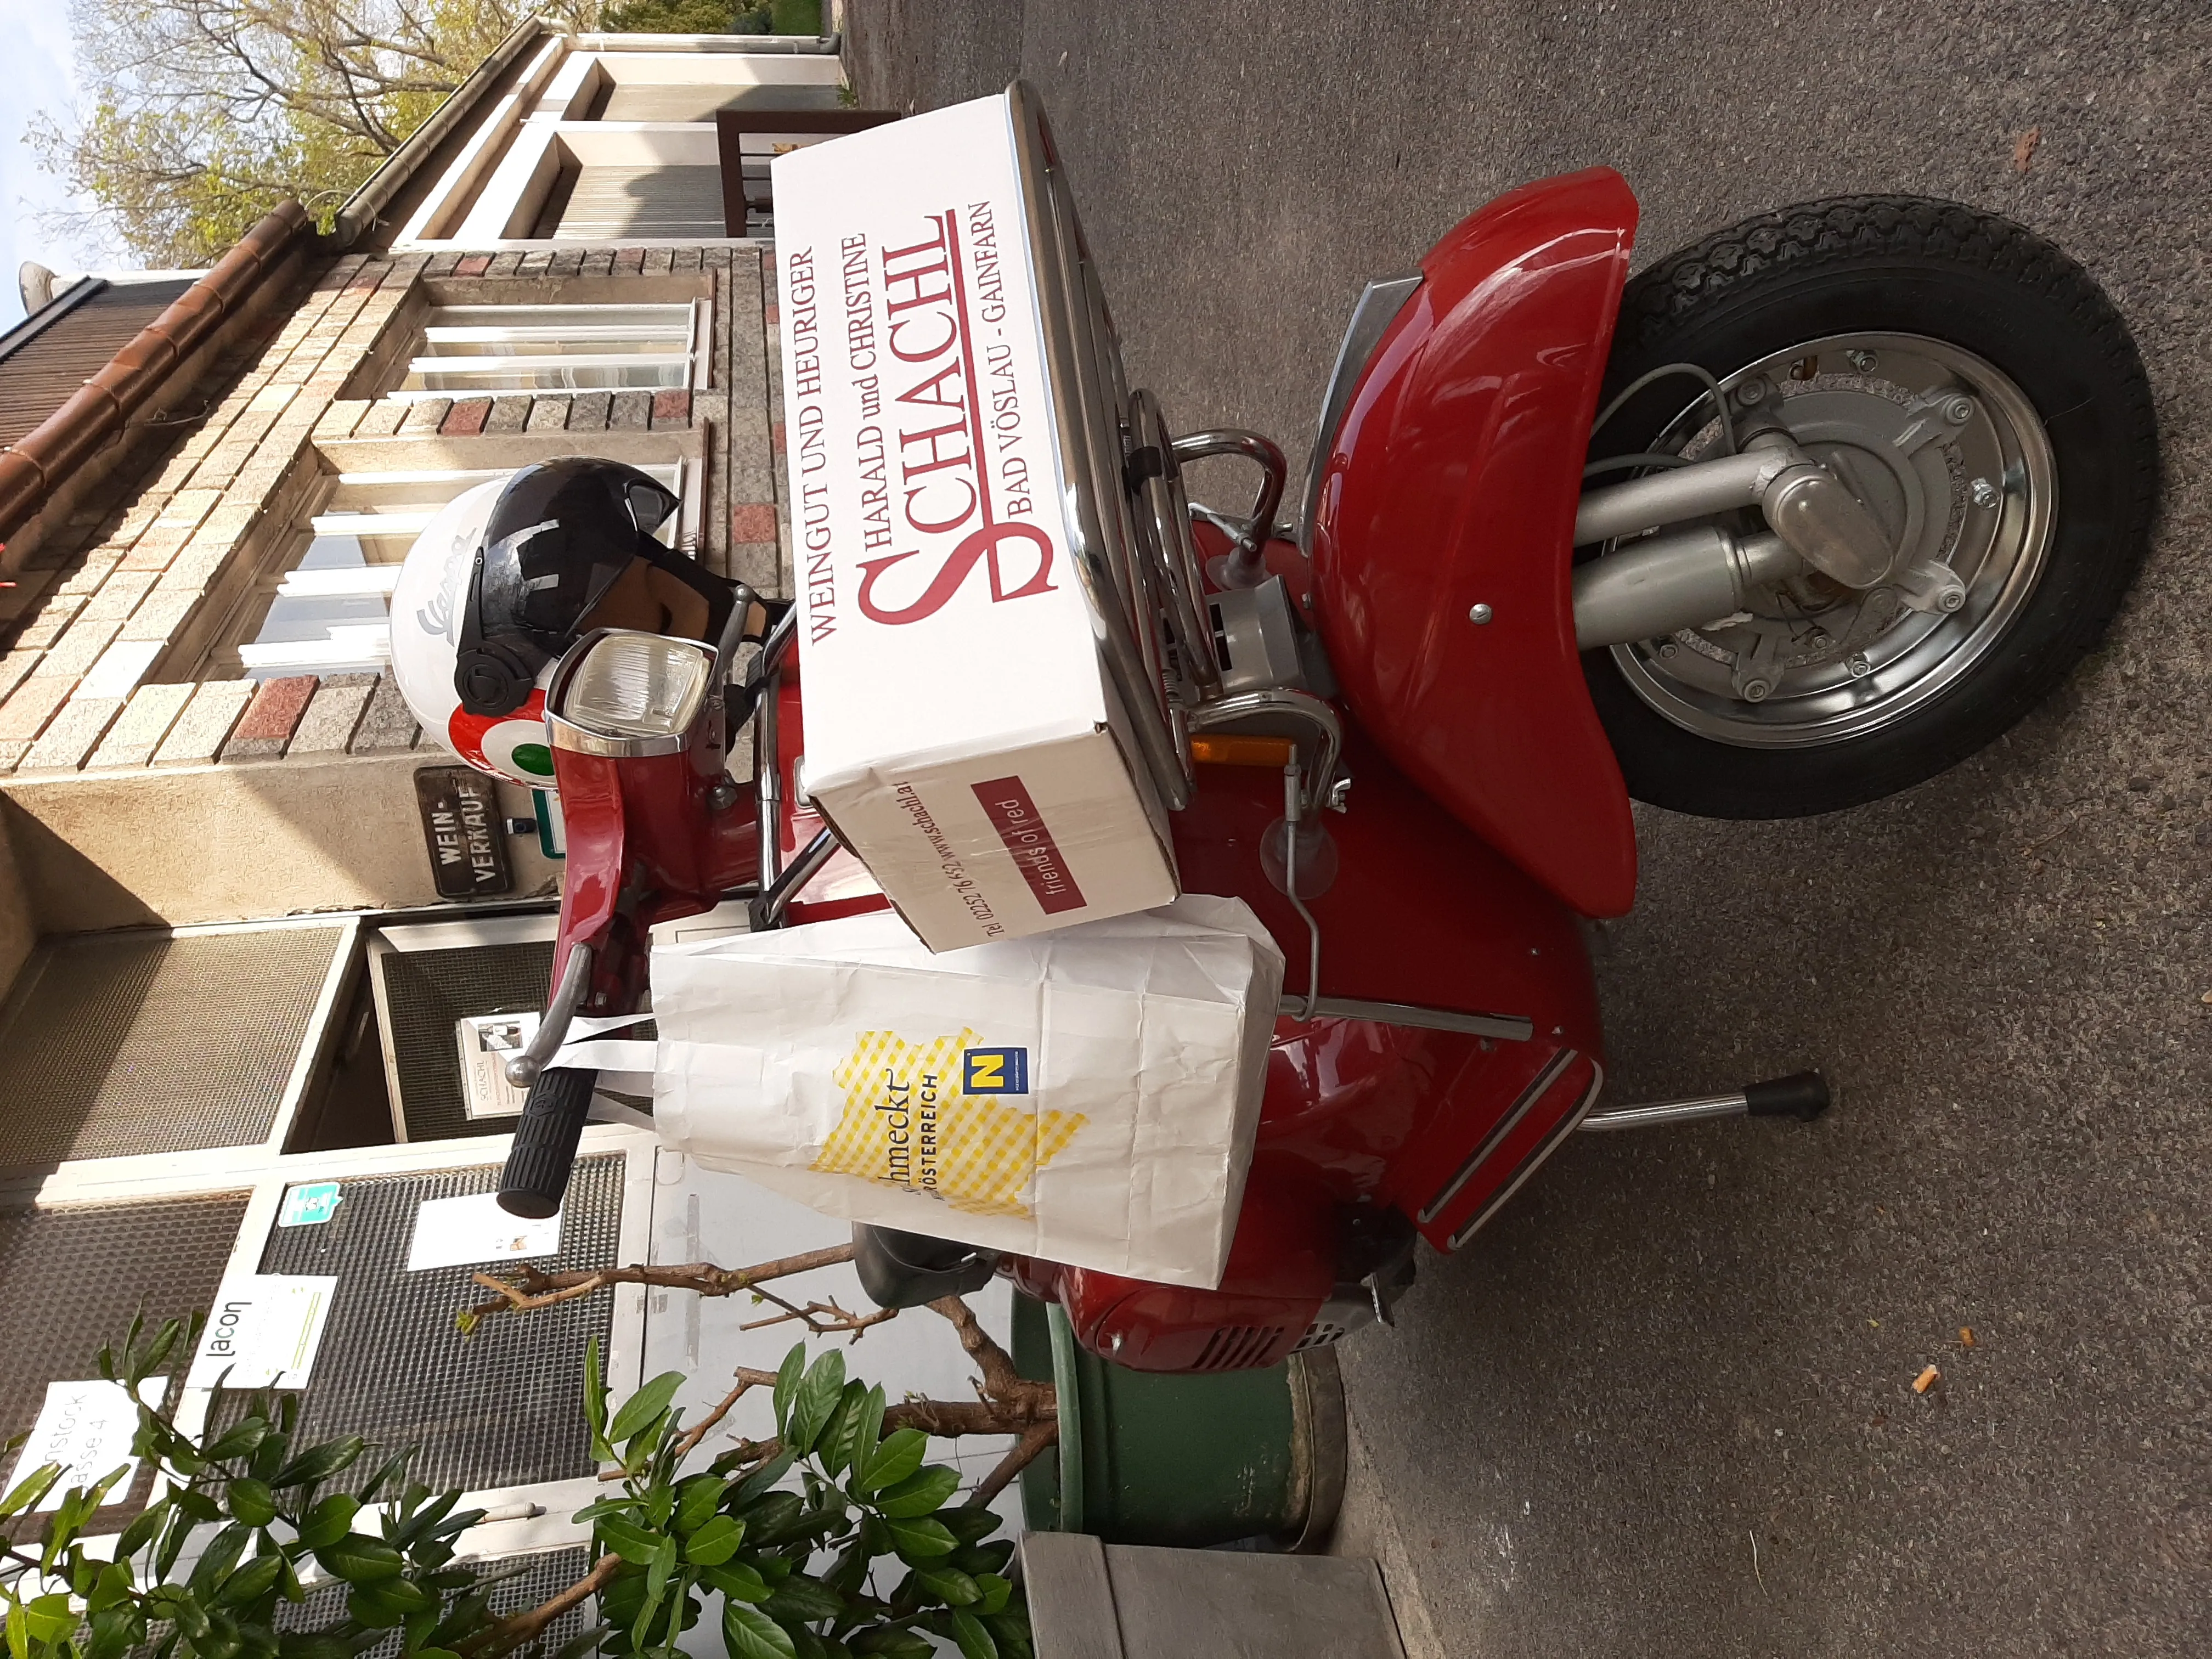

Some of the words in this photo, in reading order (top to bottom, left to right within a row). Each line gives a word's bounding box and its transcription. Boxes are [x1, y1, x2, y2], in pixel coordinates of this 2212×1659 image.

[967, 201, 1007, 323] GAINFARN
[789, 246, 821, 398] HEURIGER
[840, 233, 876, 370] CHRISTINE
[852, 375, 881, 420] und
[855, 214, 1058, 625] SCHACHL
[987, 345, 1023, 452] VÖSLAU
[799, 406, 826, 476] UND
[856, 426, 891, 551] HARALD
[1001, 456, 1032, 518] BAD
[416, 527, 478, 647] Vespa
[803, 483, 838, 646] WEINGUT
[431, 802, 462, 865] WEIN-
[458, 786, 496, 883] VERKAUF
[891, 781, 955, 861] www.schachl.at
[995, 799, 1028, 823] red
[1012, 830, 1039, 843] of
[952, 881, 976, 893] 76
[1028, 847, 1066, 895] friends
[963, 893, 994, 920] 02252
[982, 922, 1005, 937] Tel
[970, 1054, 1003, 1088] N
[205, 1302, 252, 1356] lacon
[44, 1395, 87, 1462] nstock
[89, 1419, 108, 1430] 4
